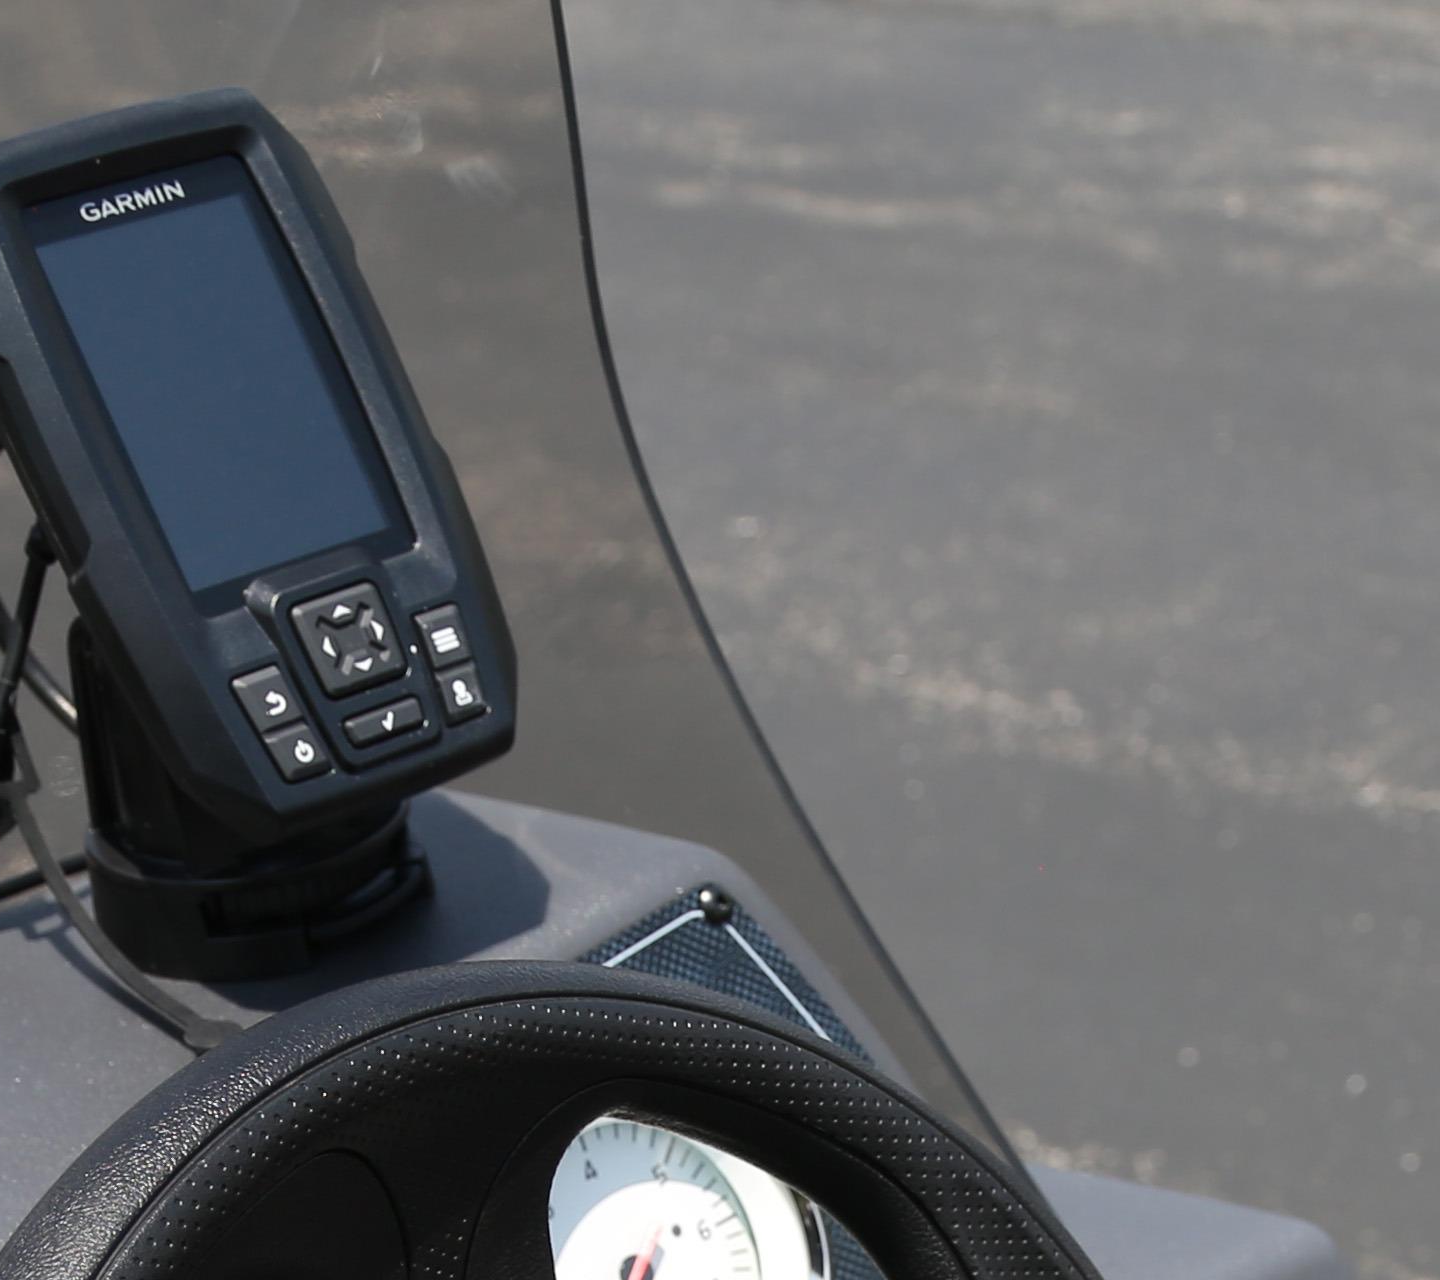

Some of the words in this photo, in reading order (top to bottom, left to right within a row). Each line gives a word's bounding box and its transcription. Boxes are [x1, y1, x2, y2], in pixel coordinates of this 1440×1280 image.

[79, 179, 186, 223] GARMIN
[584, 1159, 599, 1181] 4
[651, 1163, 670, 1188] 5
[696, 1218, 712, 1241] 6
